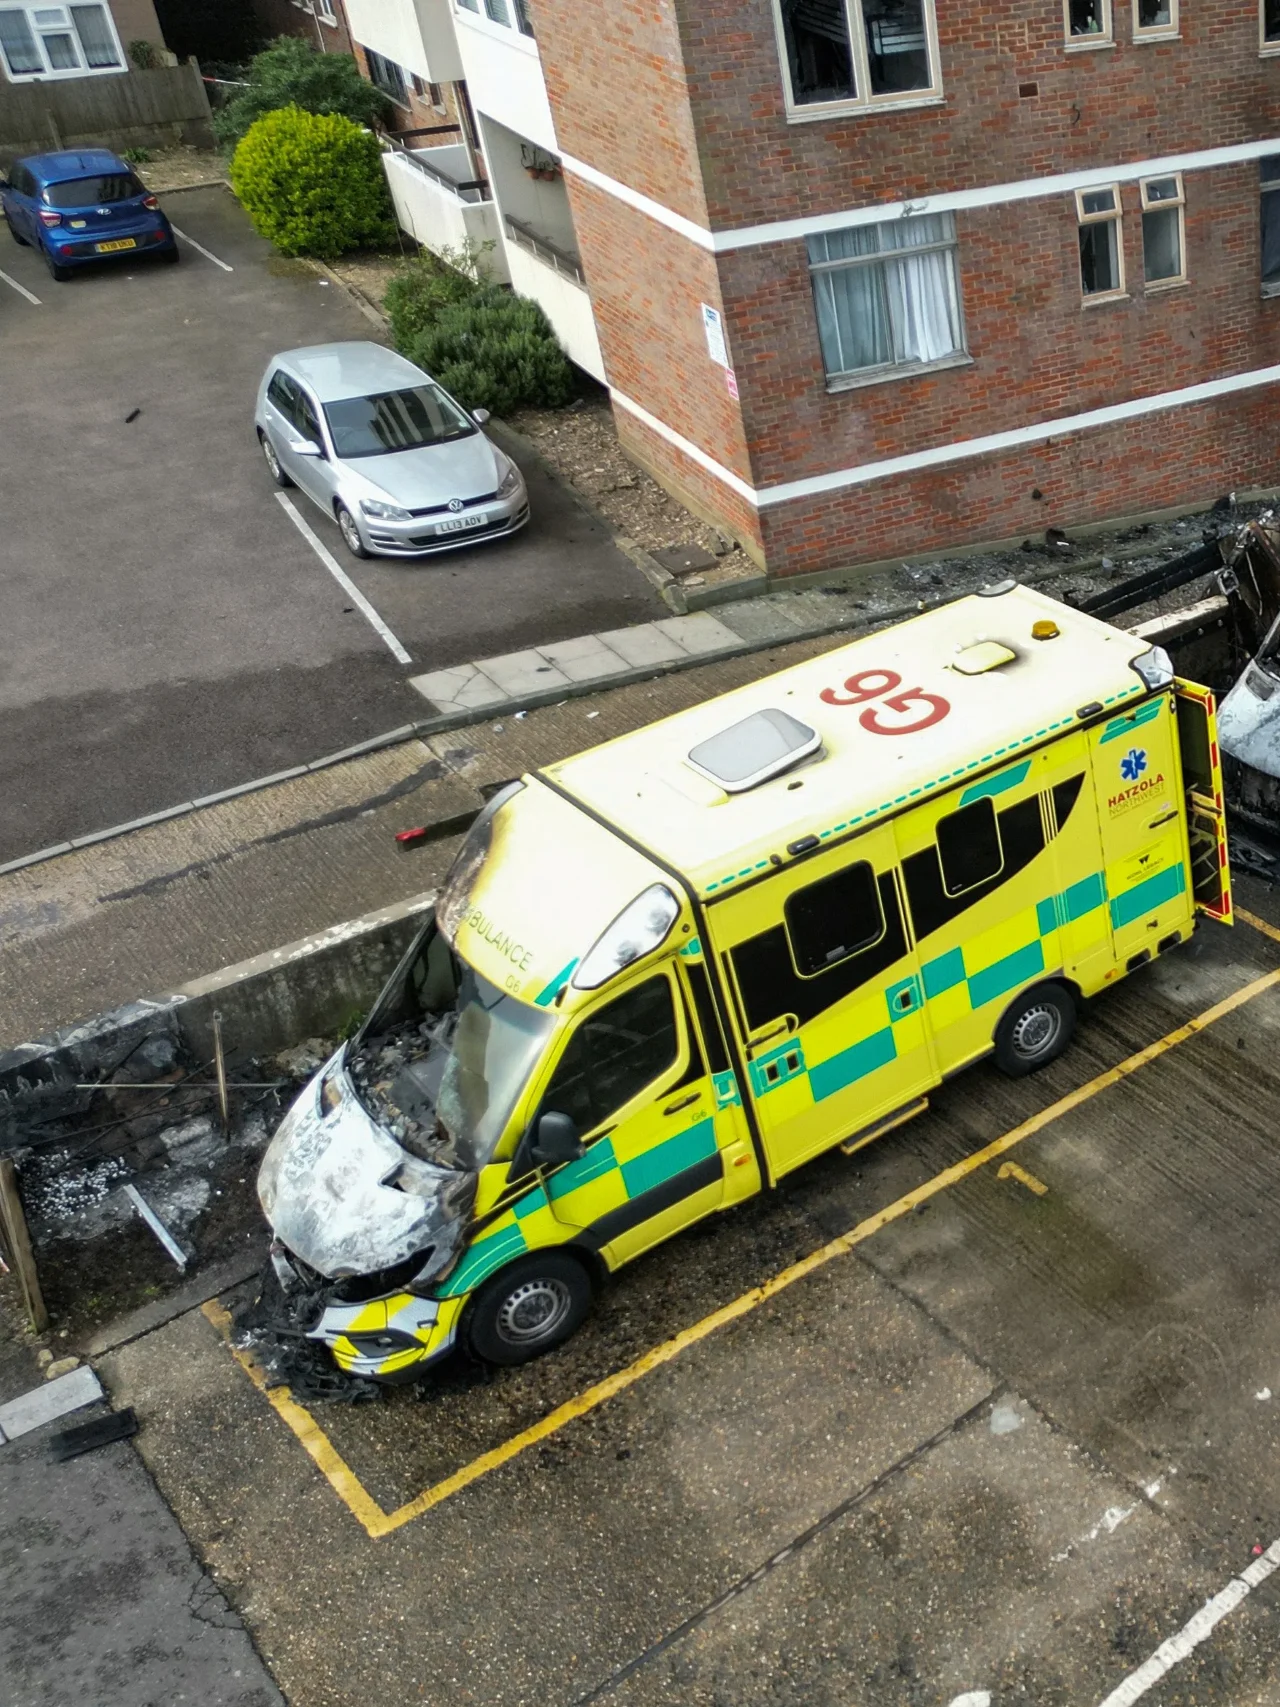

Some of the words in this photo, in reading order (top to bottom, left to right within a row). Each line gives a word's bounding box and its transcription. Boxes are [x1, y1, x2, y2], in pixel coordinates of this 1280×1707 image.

[440, 520, 462, 532] LL13
[1108, 773, 1164, 807] HATZOLA
[1109, 783, 1165, 816] NORTHWEST
[461, 904, 533, 971] BULANCE
[505, 974, 521, 993] G6
[691, 1109, 707, 1121] G6
